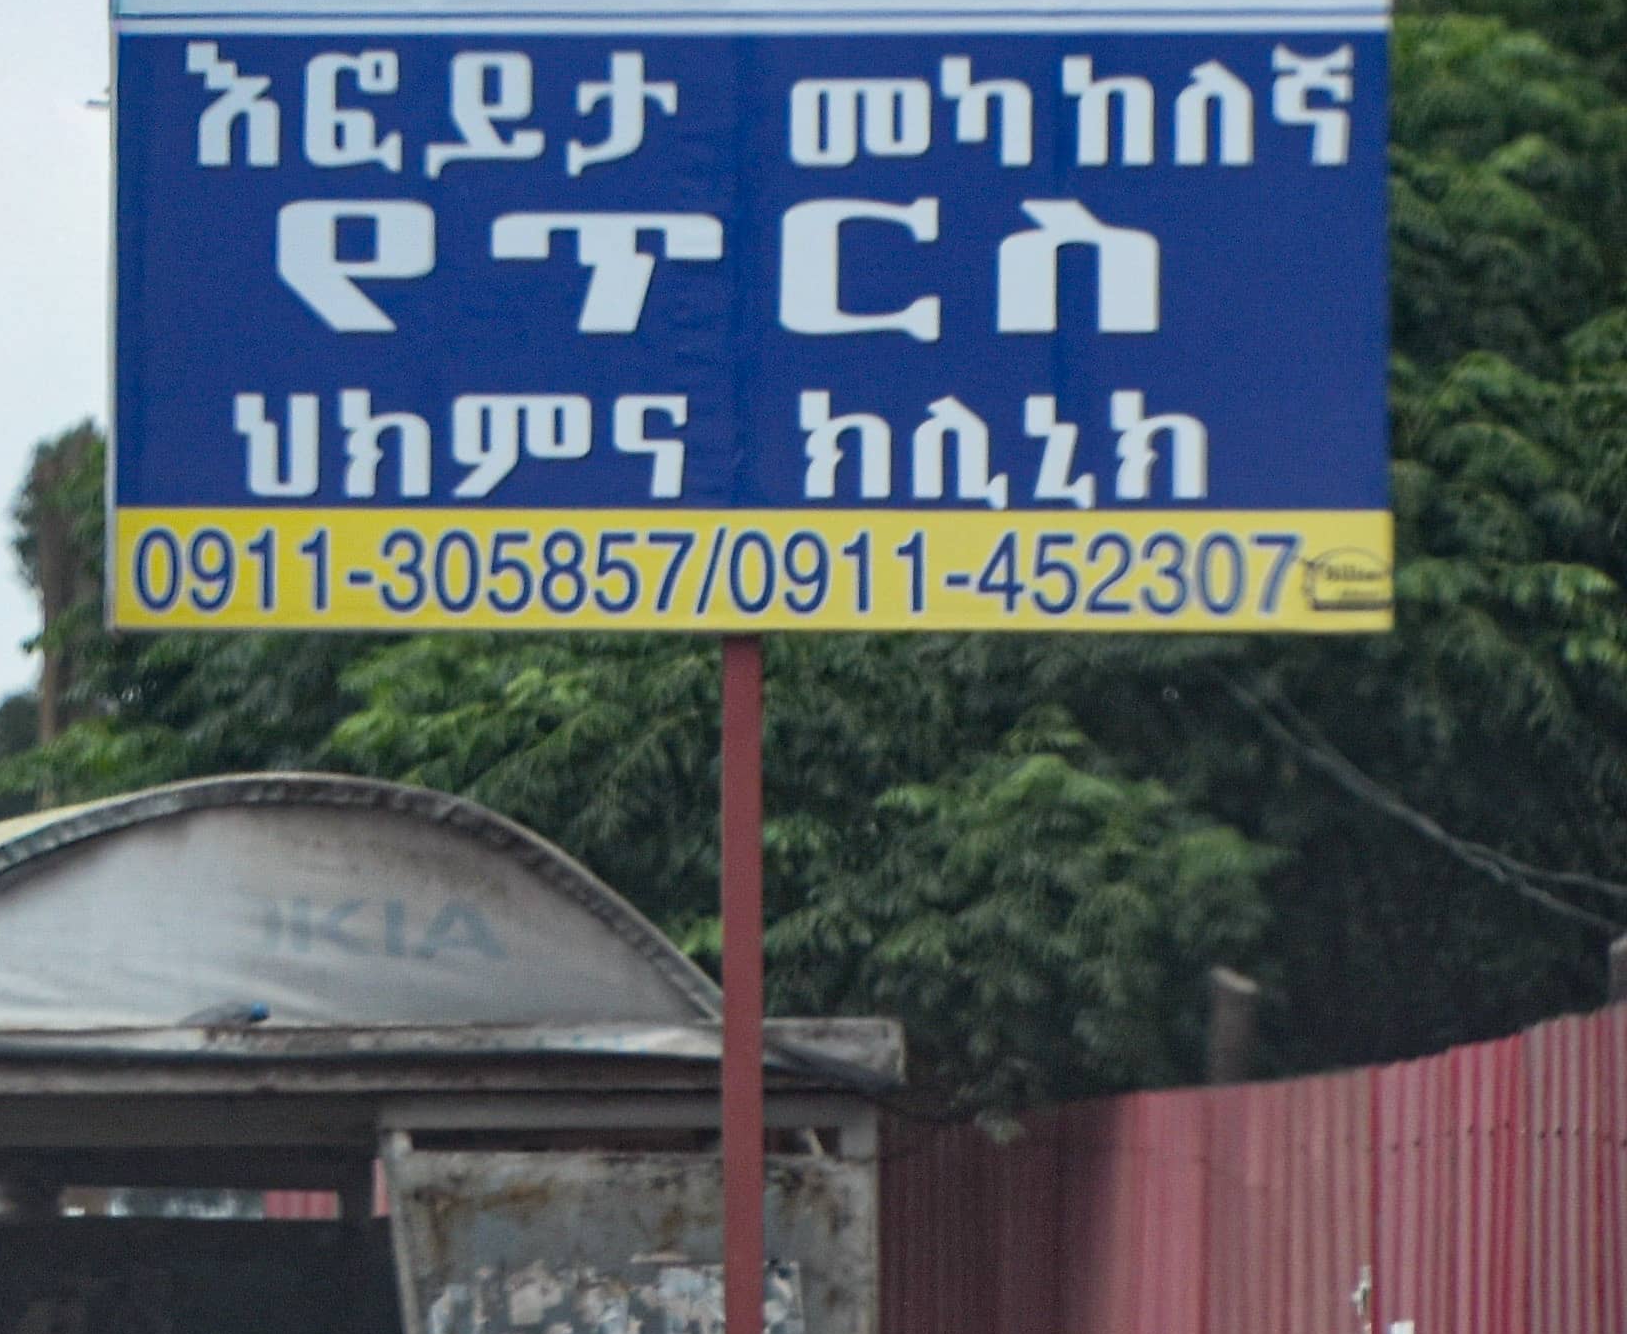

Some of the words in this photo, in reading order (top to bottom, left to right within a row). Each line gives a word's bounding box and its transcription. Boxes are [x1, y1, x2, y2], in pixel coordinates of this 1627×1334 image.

[188, 43, 677, 177] እፎይታ
[791, 45, 1352, 166] መካከለኛ
[279, 198, 1159, 340] የጥርስ
[236, 389, 687, 497] ህክምና
[800, 391, 1207, 509] ክሊኒክ
[133, 528, 1298, 615] 0911-305857/0911-452307
